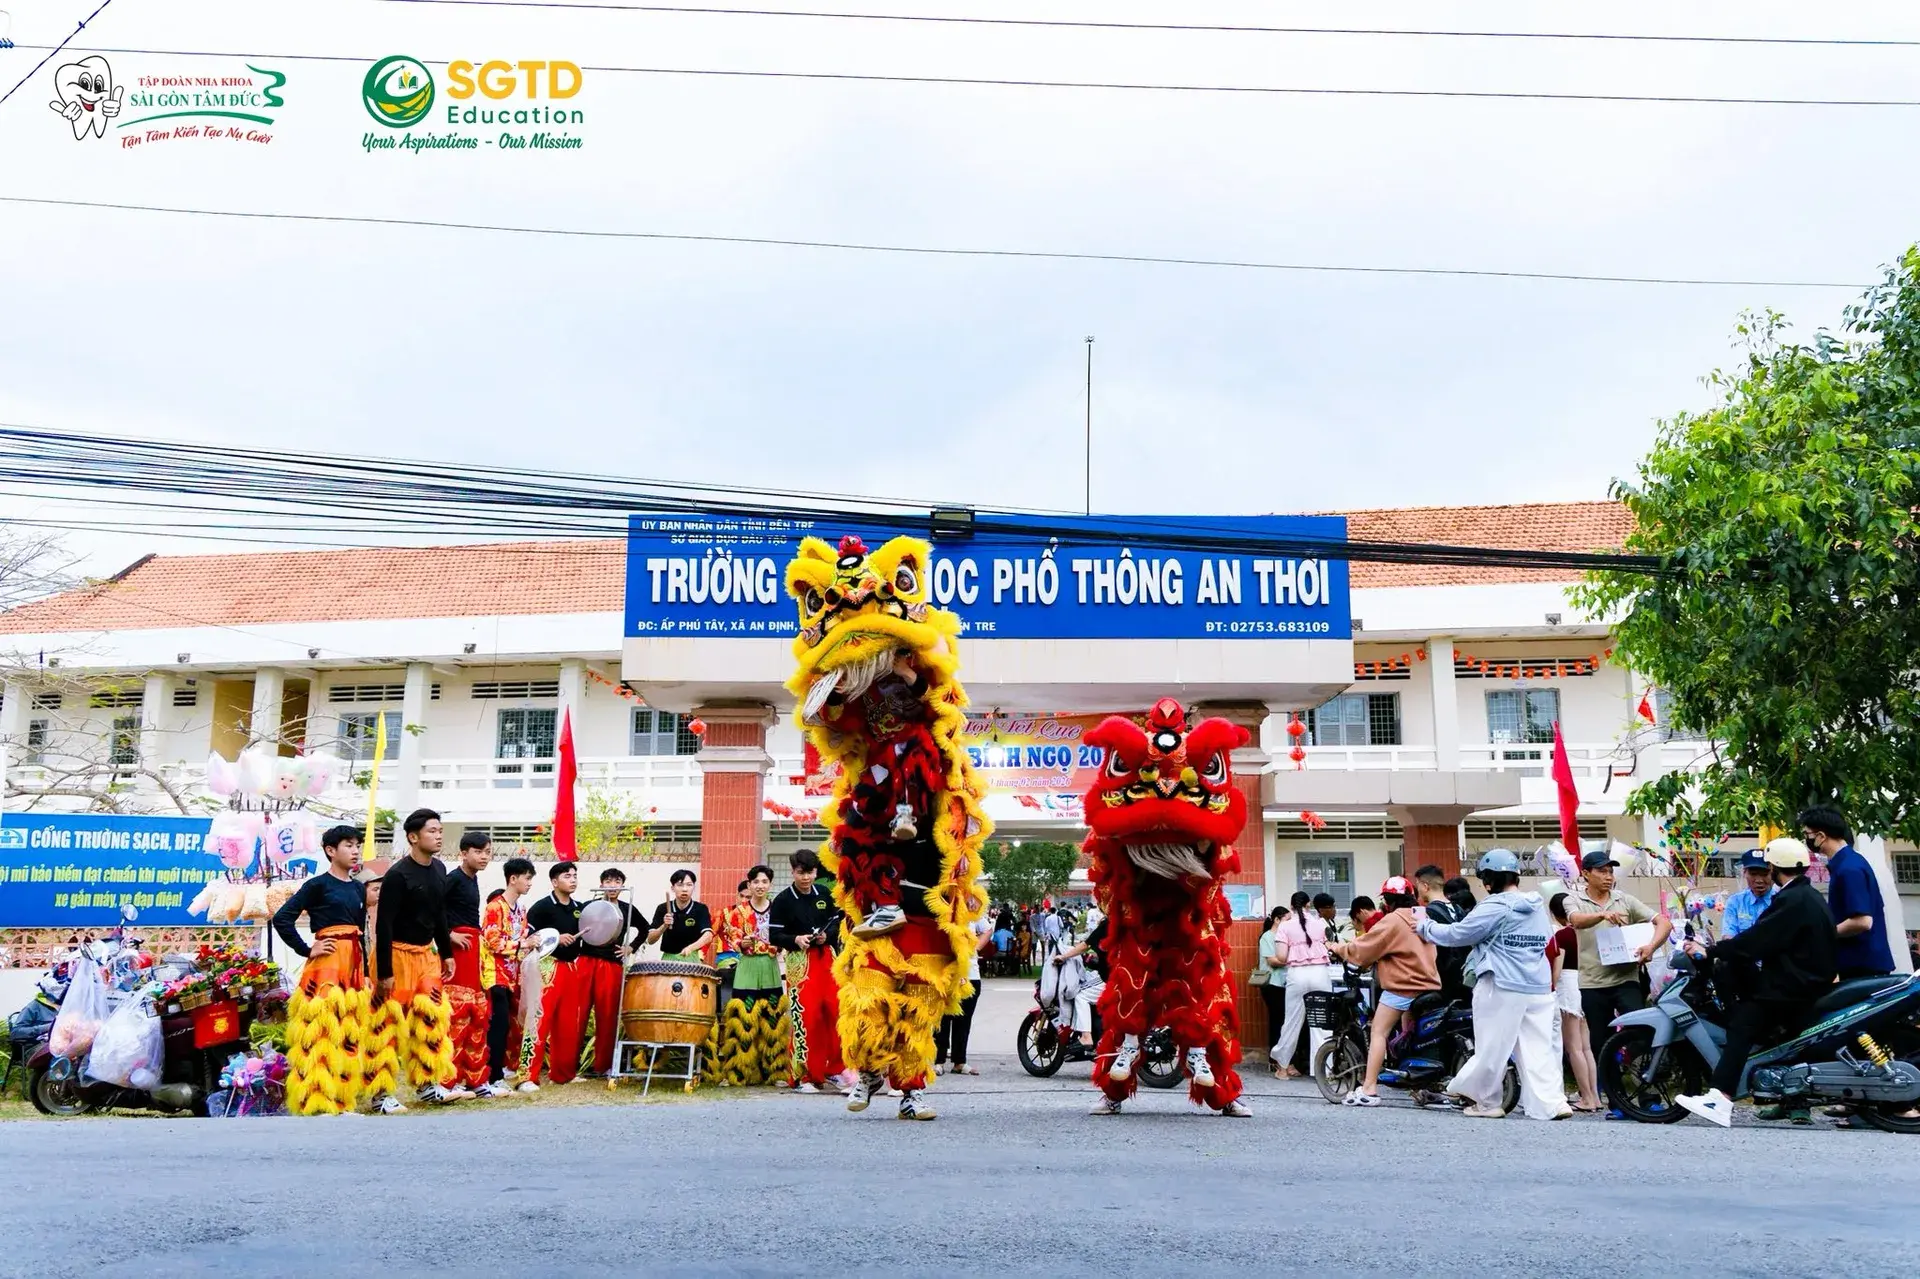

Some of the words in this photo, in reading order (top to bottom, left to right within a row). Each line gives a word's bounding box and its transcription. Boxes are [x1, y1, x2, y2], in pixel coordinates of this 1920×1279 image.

[659, 521, 683, 531] BAN
[684, 519, 713, 531] NHÂN
[794, 521, 815, 531] TRE
[647, 547, 778, 605] TRƯỜNG
[993, 536, 1060, 605] PHỐ
[1072, 548, 1184, 605] THÔNG
[1197, 559, 1242, 604] AN
[638, 621, 658, 631] ĐC:
[660, 617, 676, 631] ẤP
[679, 618, 701, 631] PHÚ
[704, 619, 728, 632] TÂY,
[730, 619, 746, 631] XÃ
[749, 621, 765, 631] AN
[768, 621, 798, 633] ĐỊNH,
[975, 621, 997, 631] TRE
[1206, 621, 1228, 632] ĐT:
[1230, 621, 1330, 633] 02753.683109
[1027, 746, 1072, 772] NGỌ
[31, 825, 72, 849] CỔNG
[74, 828, 131, 849] TRƯỜNG
[132, 832, 172, 854] SẠCH,
[174, 833, 201, 855] ĐẸP,
[10, 865, 29, 882] mũ
[31, 863, 53, 882] bảo
[54, 863, 82, 883] hiểm
[84, 867, 103, 886] đạt
[103, 864, 137, 883] chuẩn
[138, 867, 156, 883] khi
[182, 867, 203, 883] trên
[54, 893, 69, 907] xe
[69, 888, 92, 909] gắn
[92, 890, 118, 909] máy,
[119, 893, 132, 907] xe
